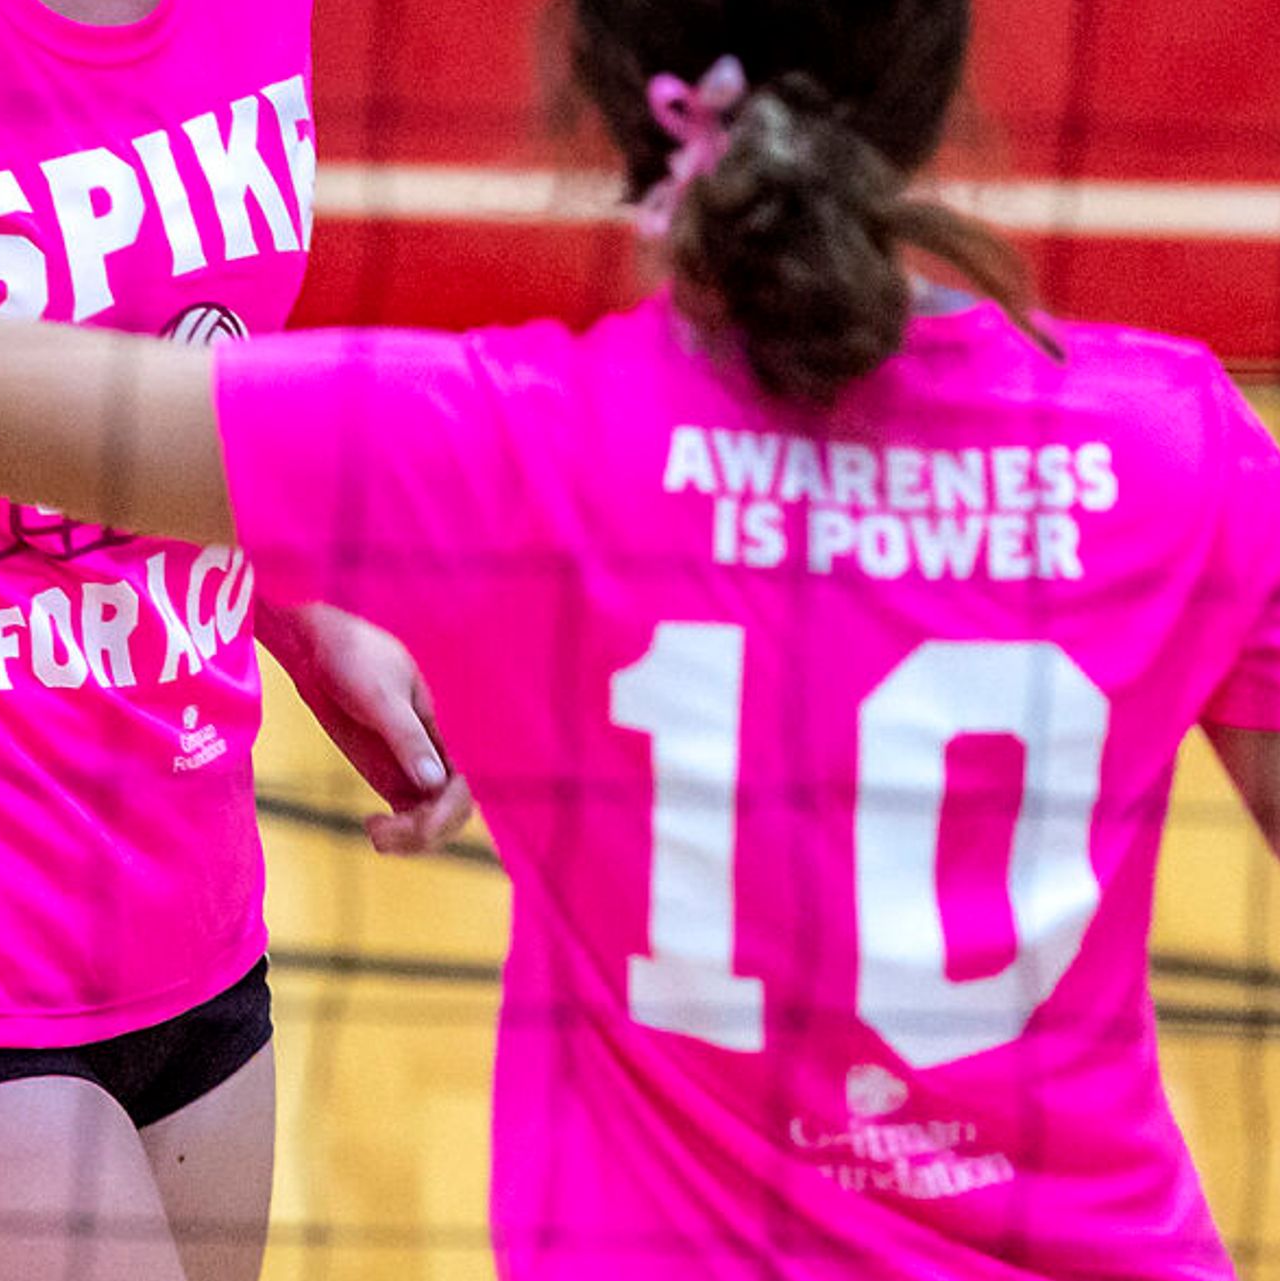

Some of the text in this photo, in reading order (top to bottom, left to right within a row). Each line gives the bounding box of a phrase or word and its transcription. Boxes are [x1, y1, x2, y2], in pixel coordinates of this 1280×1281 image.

[663, 425, 1118, 512] AWARENESS
[713, 500, 1083, 580] IS POWER
[145, 551, 203, 684] A
[609, 621, 1110, 1070] 10
